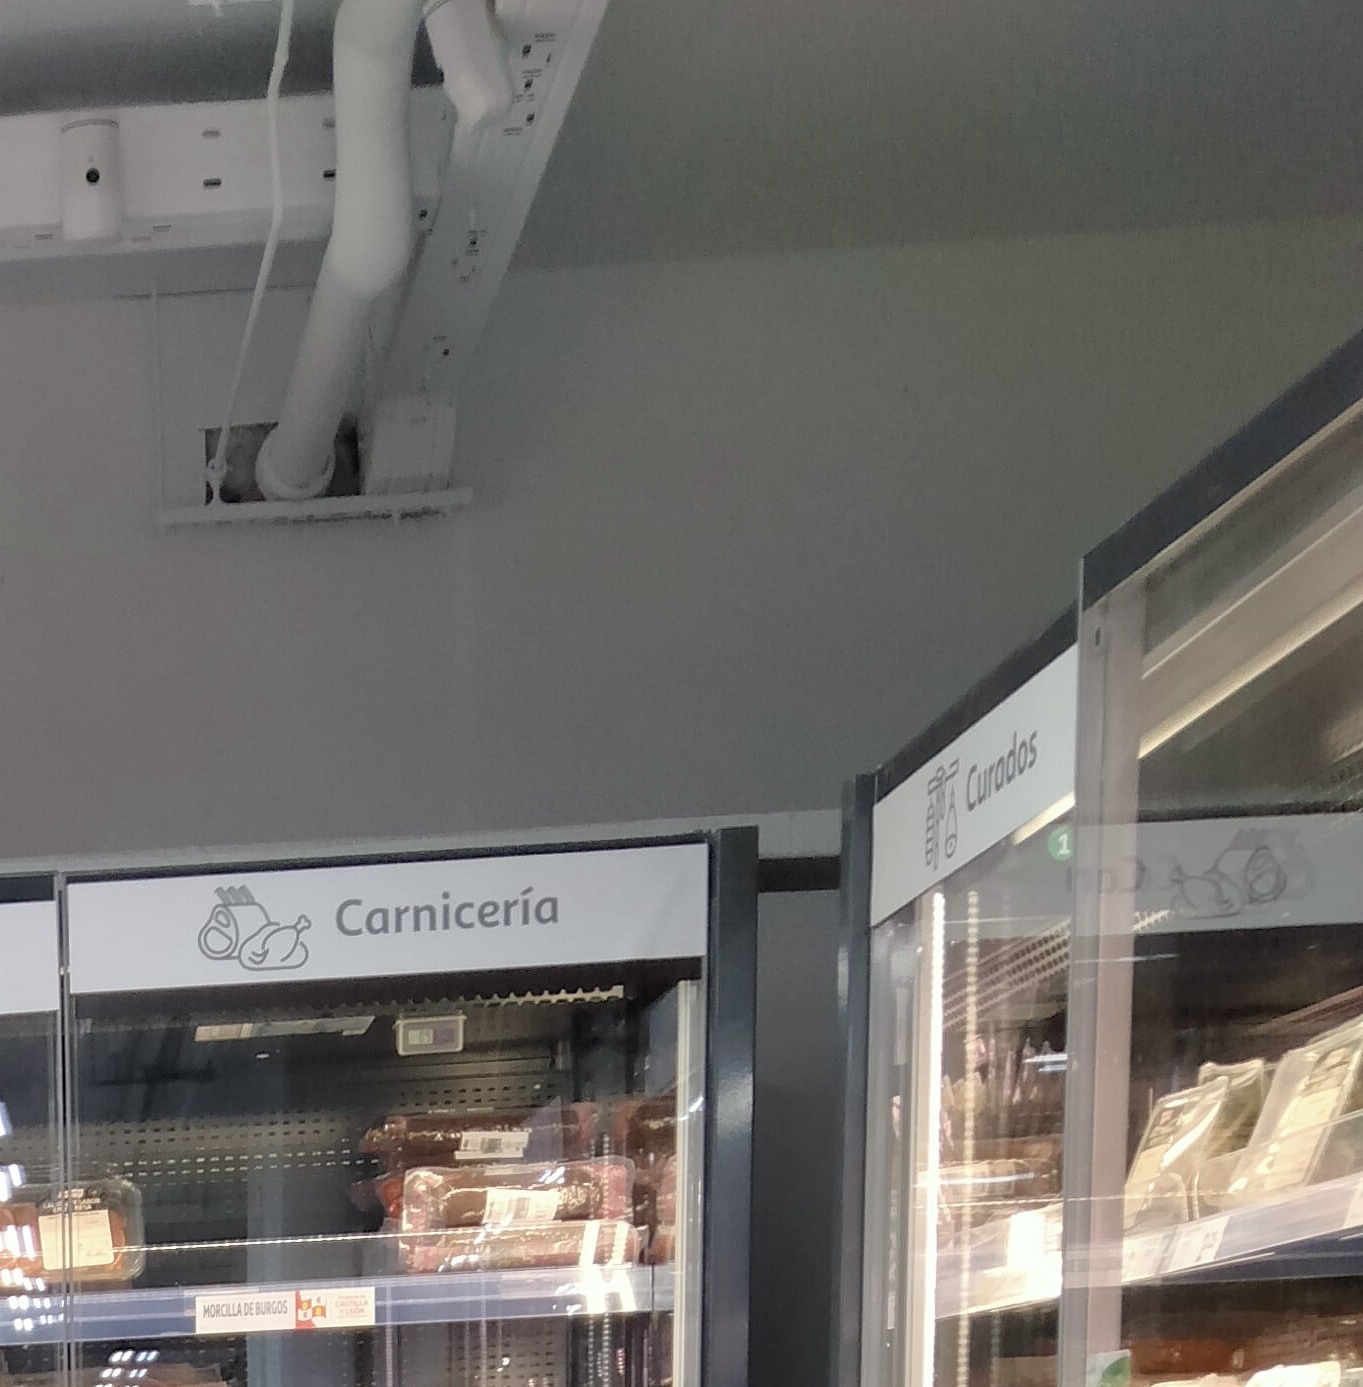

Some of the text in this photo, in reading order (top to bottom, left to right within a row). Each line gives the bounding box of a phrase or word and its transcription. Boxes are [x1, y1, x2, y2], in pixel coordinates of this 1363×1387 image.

[966, 730, 1037, 812] Curados
[1057, 833, 1071, 856] 1
[336, 886, 559, 937] Carnicería
[203, 1300, 288, 1319] MORCILLA DE BURGOS
